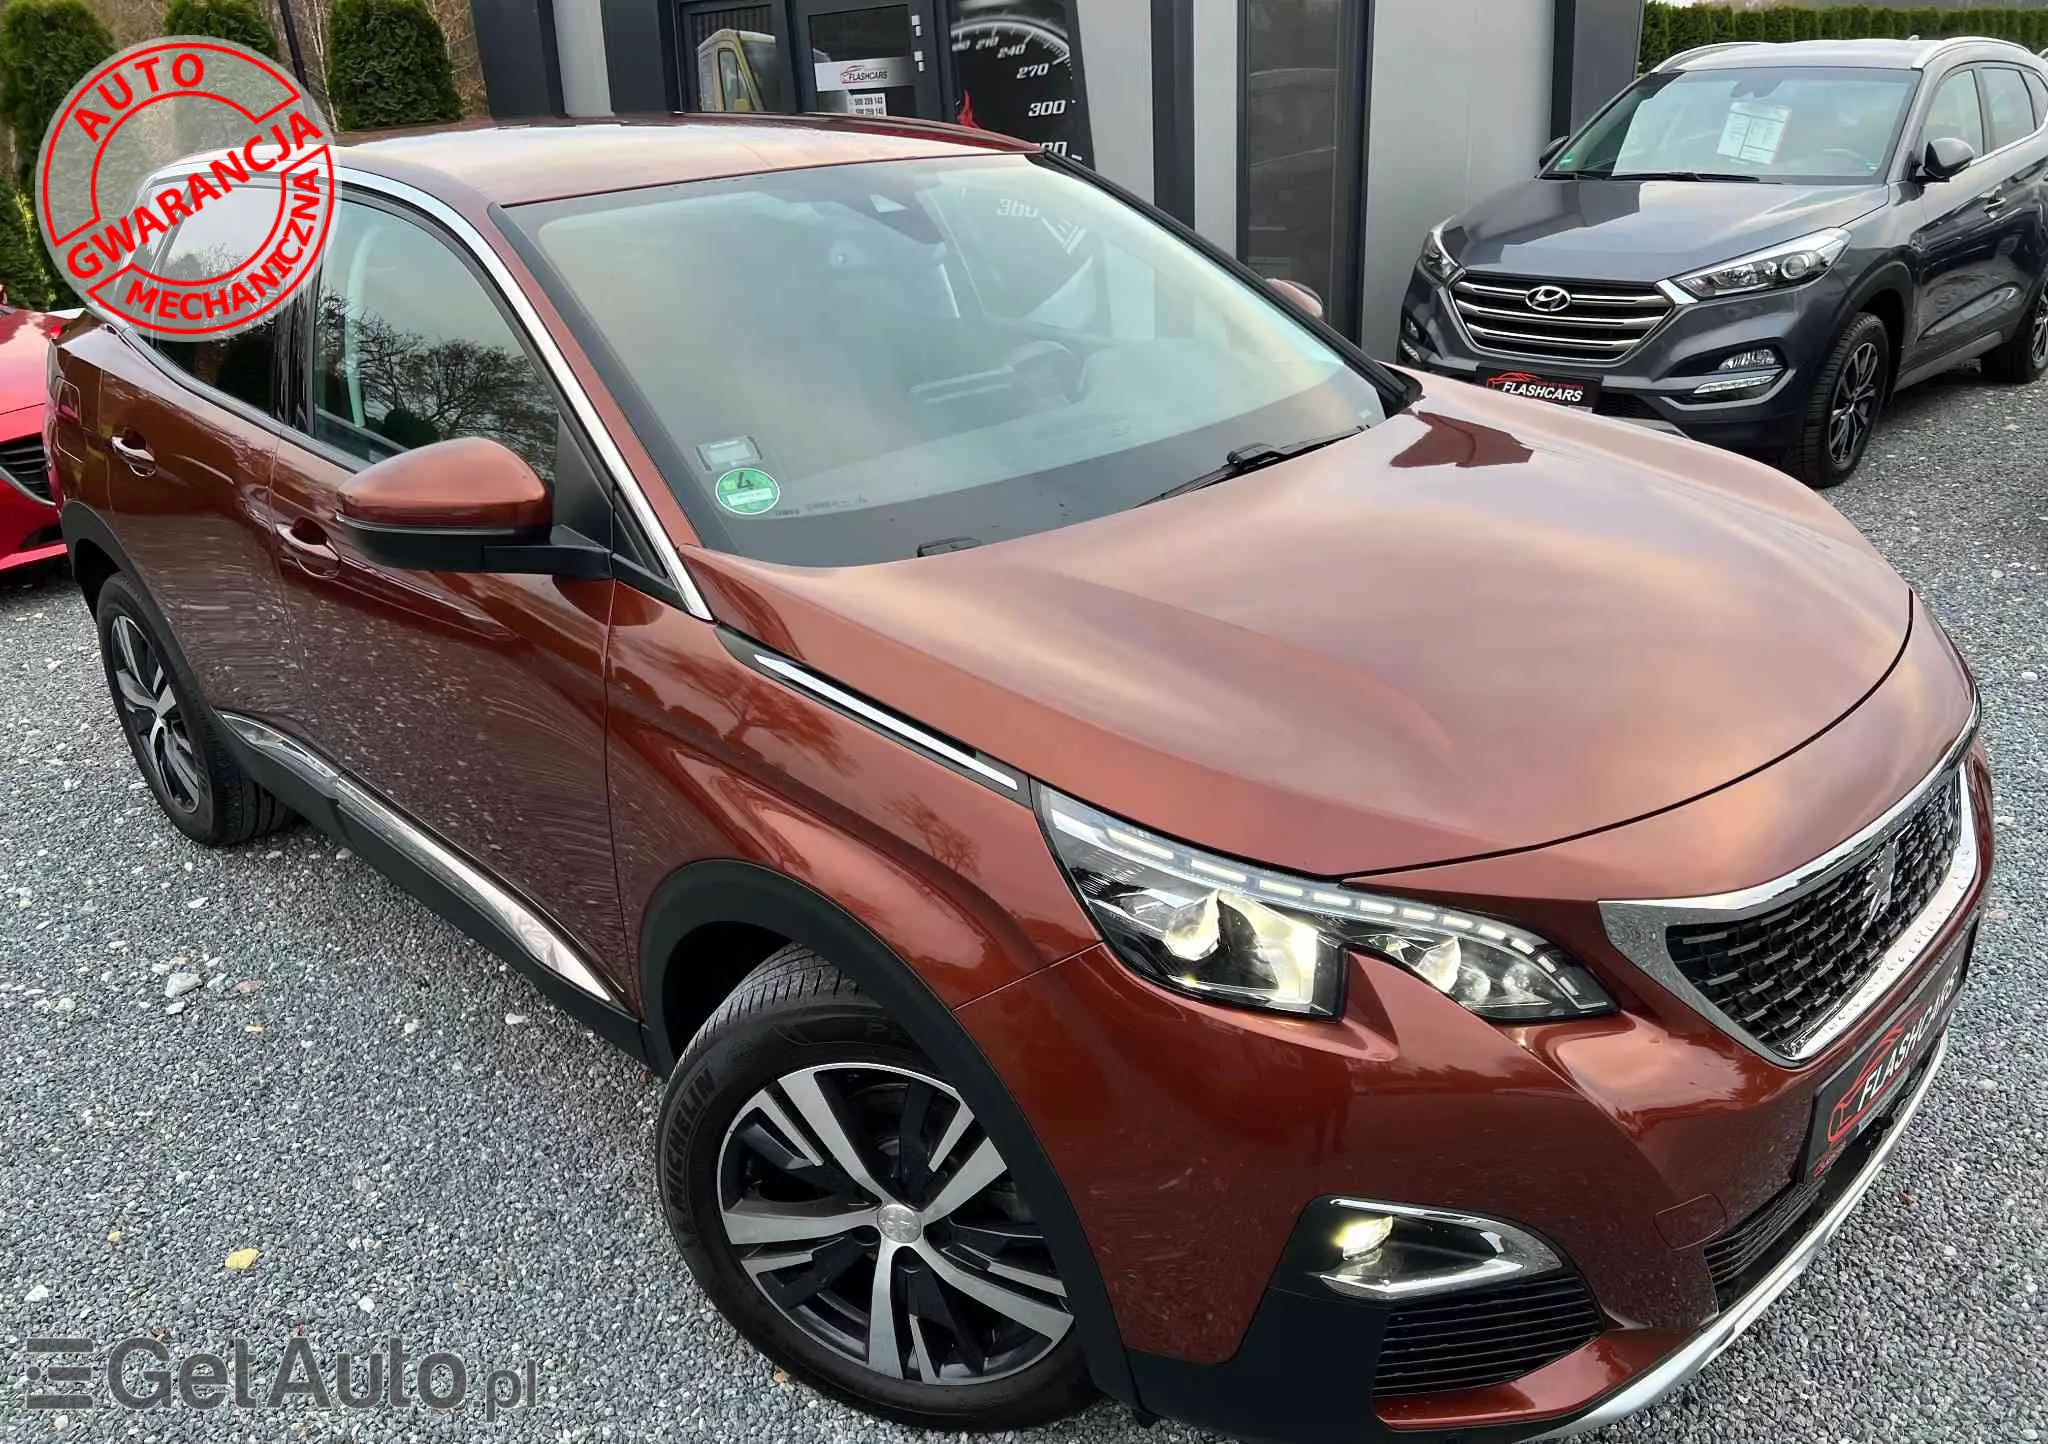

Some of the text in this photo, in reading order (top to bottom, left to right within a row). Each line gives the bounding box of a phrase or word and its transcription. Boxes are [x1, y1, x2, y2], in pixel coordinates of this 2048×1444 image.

[997, 43, 1027, 58] 240
[848, 71, 888, 81] FLASHCARS
[1016, 63, 1050, 79] 270
[1028, 100, 1066, 117] 300
[1502, 381, 1583, 402] FLASHCARS
[737, 472, 753, 490] 4
[665, 1066, 719, 1211] MICHELIN
